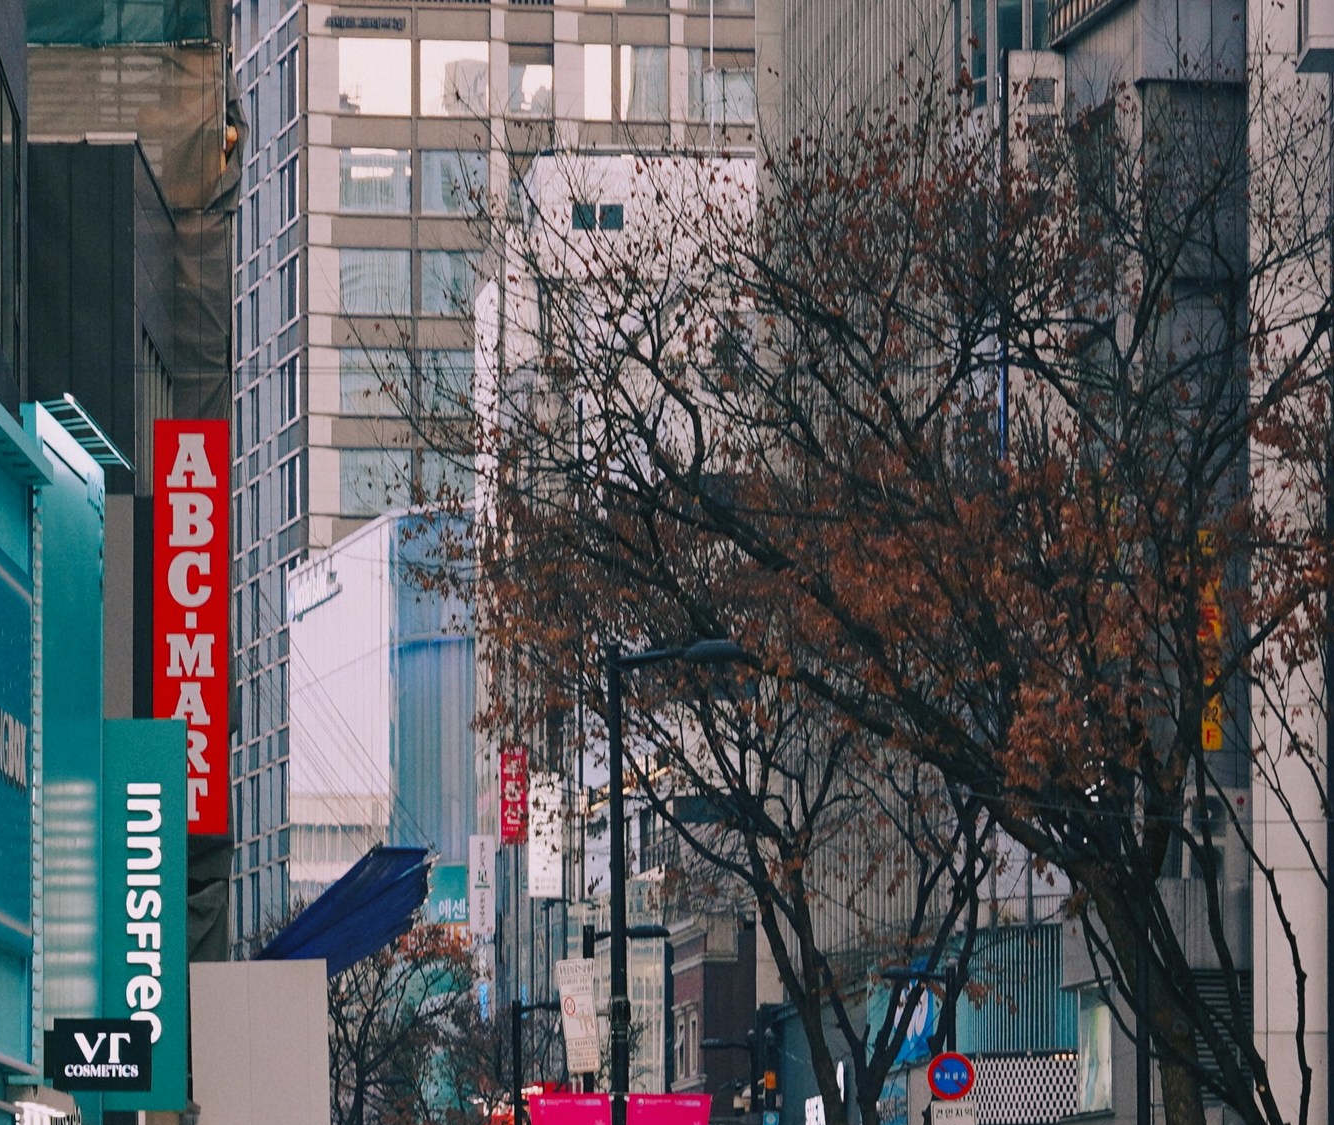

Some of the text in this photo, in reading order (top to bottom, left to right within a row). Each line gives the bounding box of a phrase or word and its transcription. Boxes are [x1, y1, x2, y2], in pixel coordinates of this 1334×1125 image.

[74, 1033, 131, 1063] VT
[64, 1064, 139, 1078] COSMETICS
[935, 1106, 973, 1119] 견인지역
